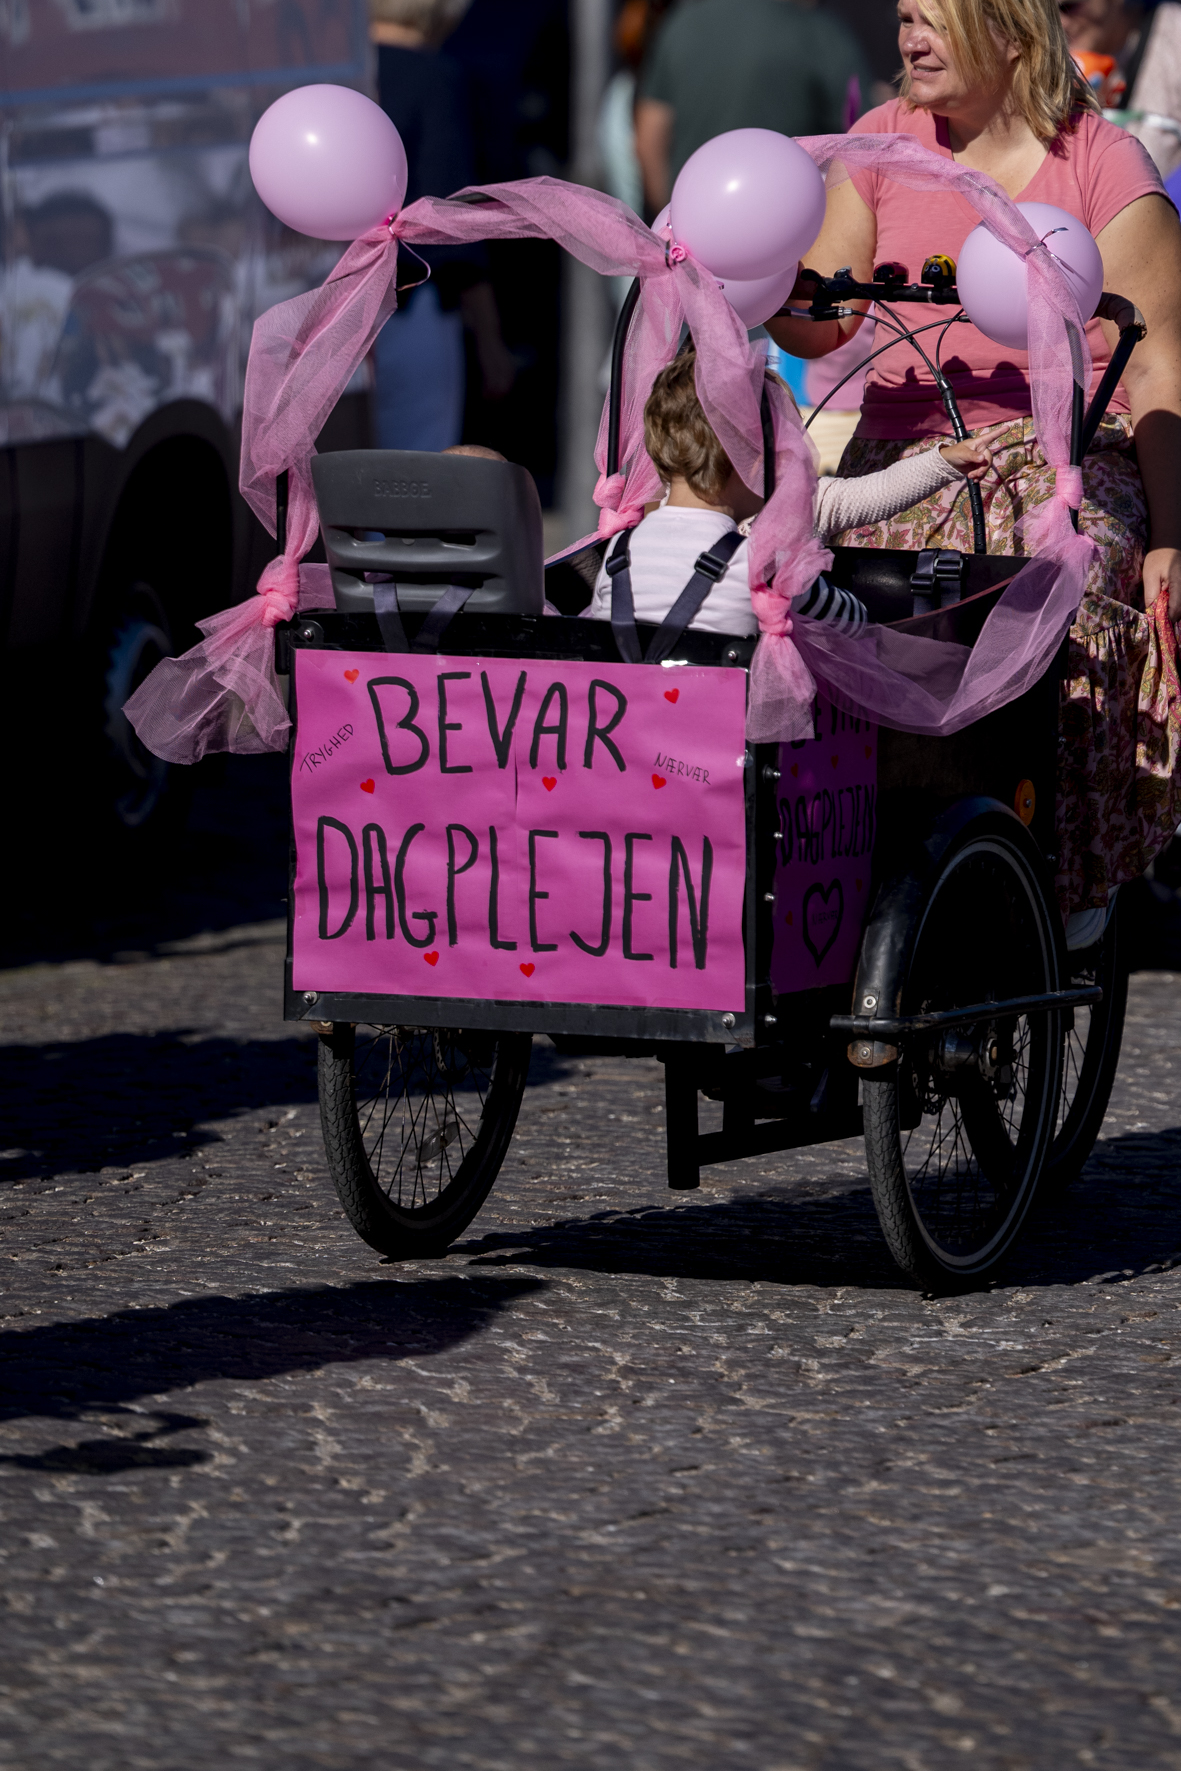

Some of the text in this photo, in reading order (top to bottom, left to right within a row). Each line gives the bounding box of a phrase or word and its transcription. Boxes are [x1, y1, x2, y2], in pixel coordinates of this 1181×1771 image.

[373, 479, 432, 498] BABBOE
[299, 723, 354, 773] TRYGHED
[367, 670, 627, 775] BEVAR
[653, 751, 711, 786] NÆRVÆR
[779, 784, 875, 867] DAGPLEJEN
[316, 815, 713, 970] DAGPLEJEN
